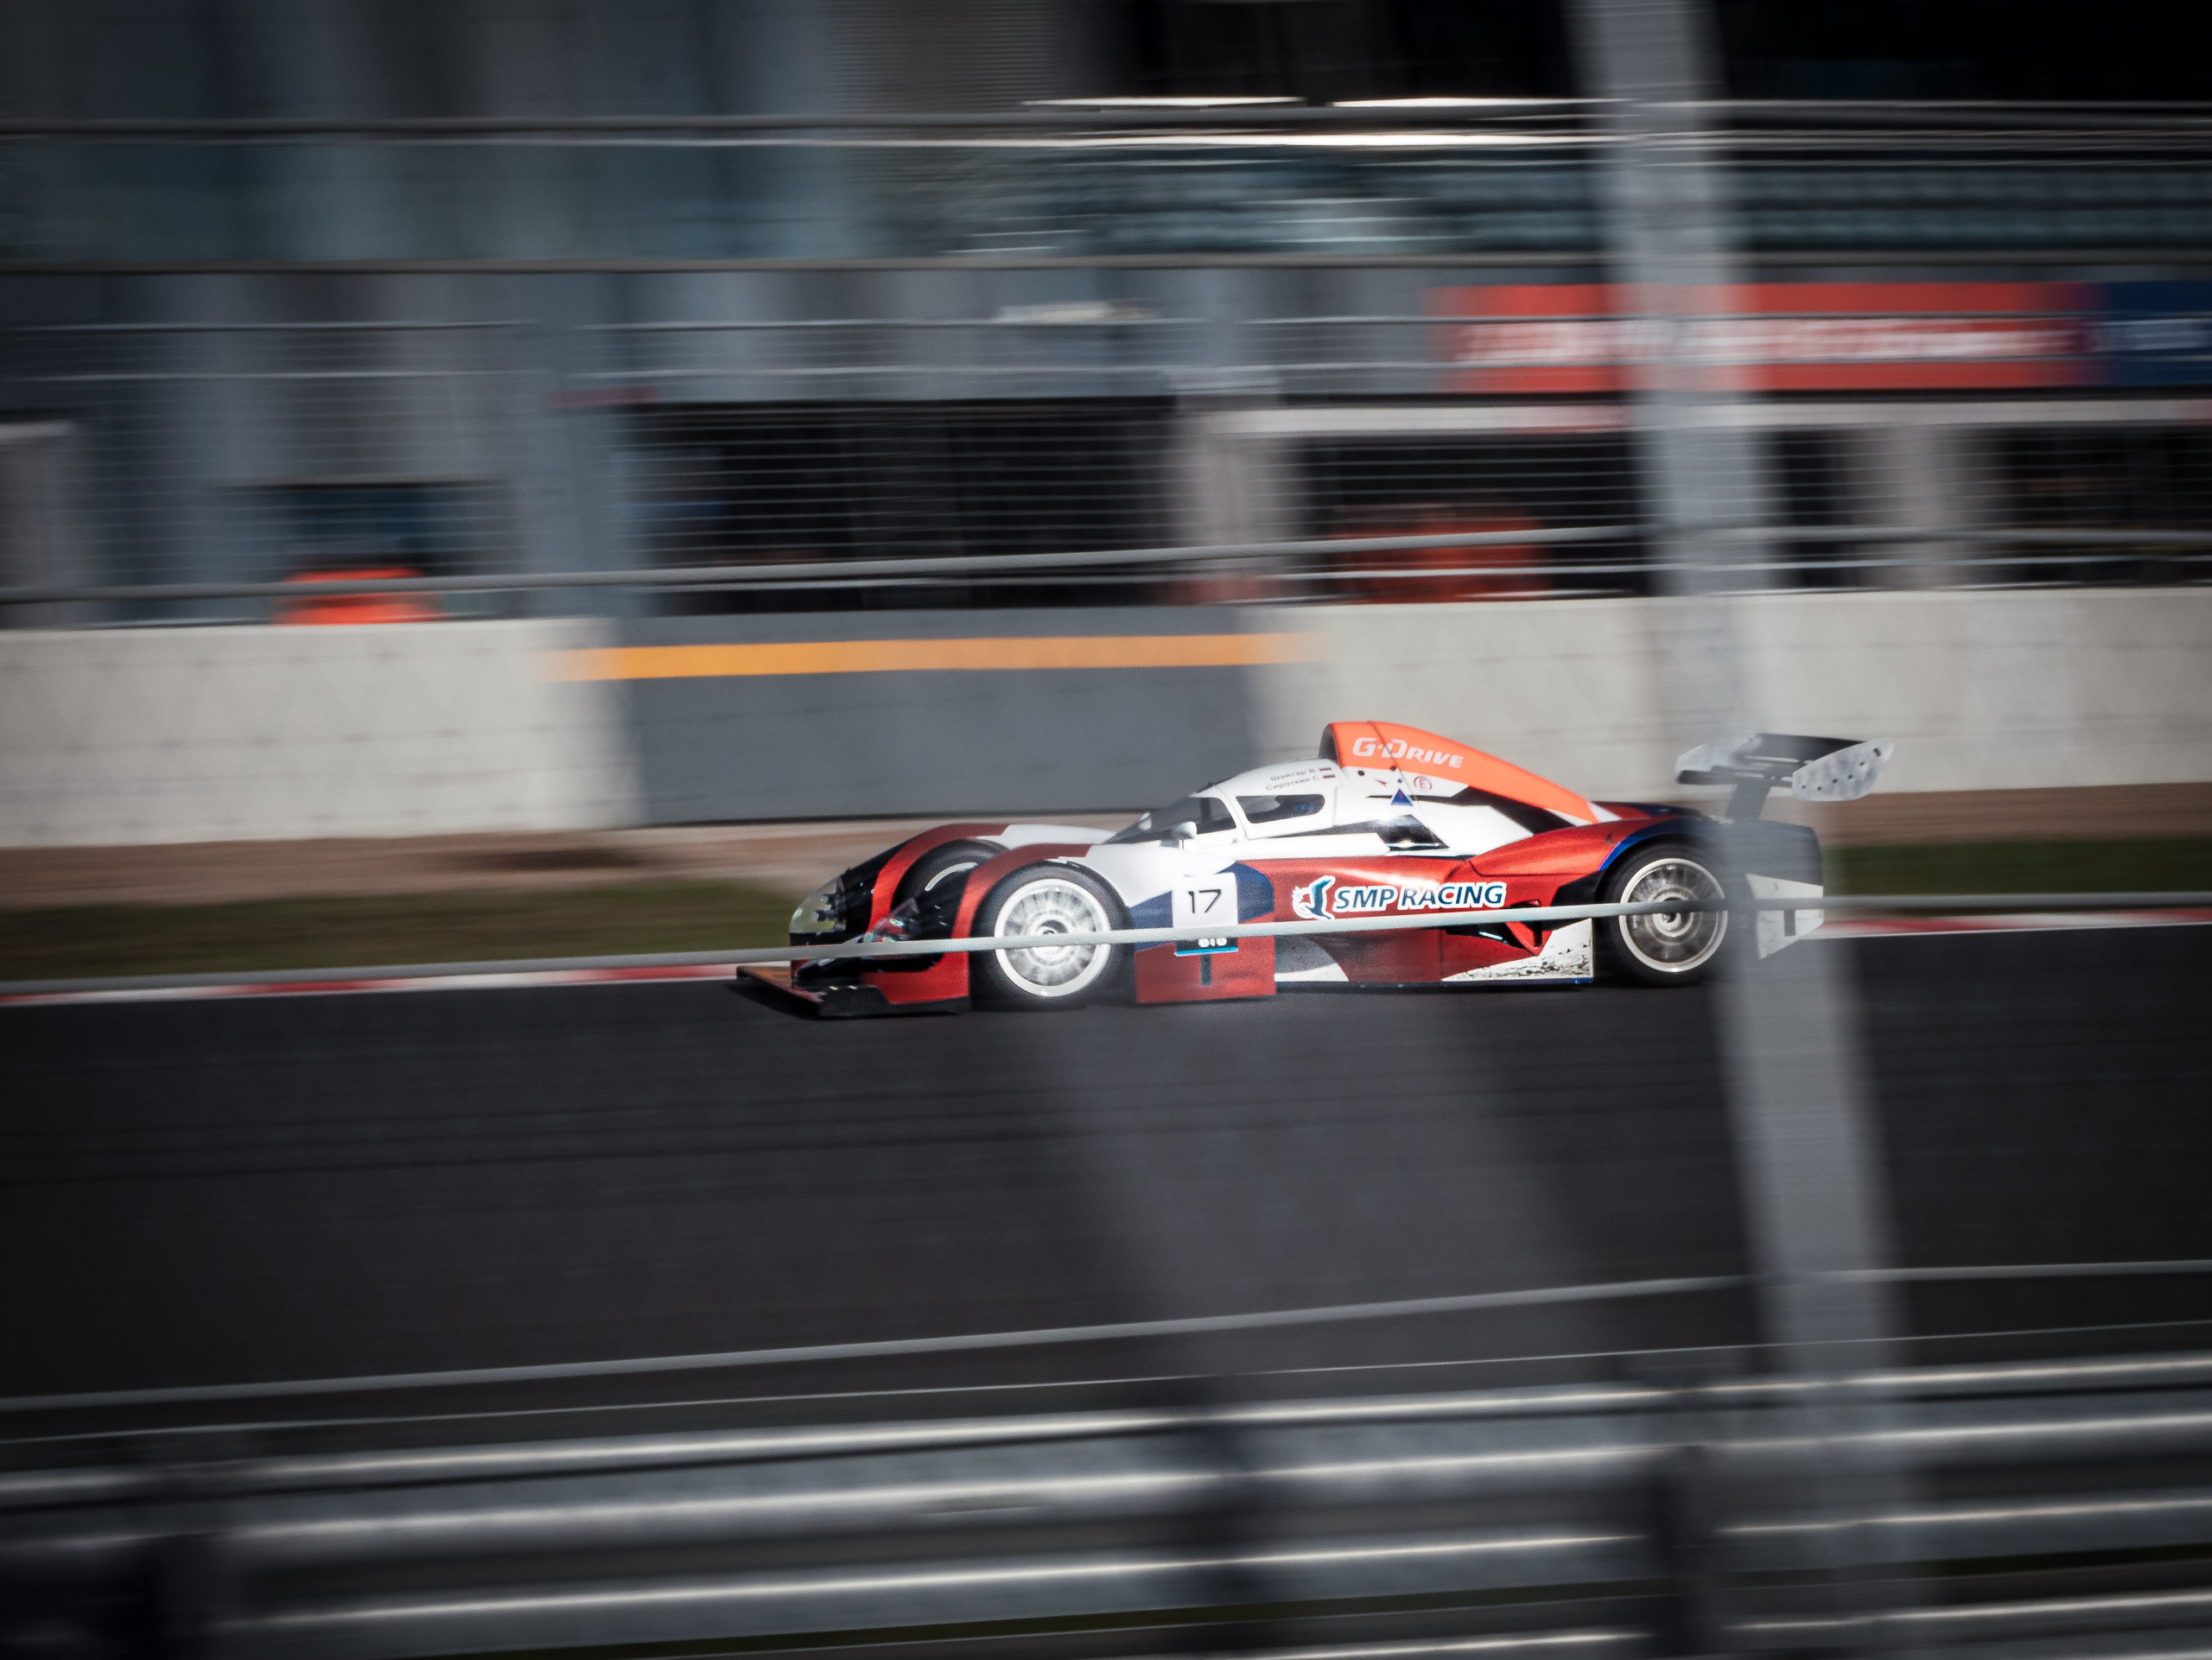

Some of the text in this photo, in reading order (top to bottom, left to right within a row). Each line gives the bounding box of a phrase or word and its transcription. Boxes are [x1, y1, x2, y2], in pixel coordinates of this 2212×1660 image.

[1188, 888, 1222, 913] 17
[1336, 885, 1504, 909] SMP RACING
